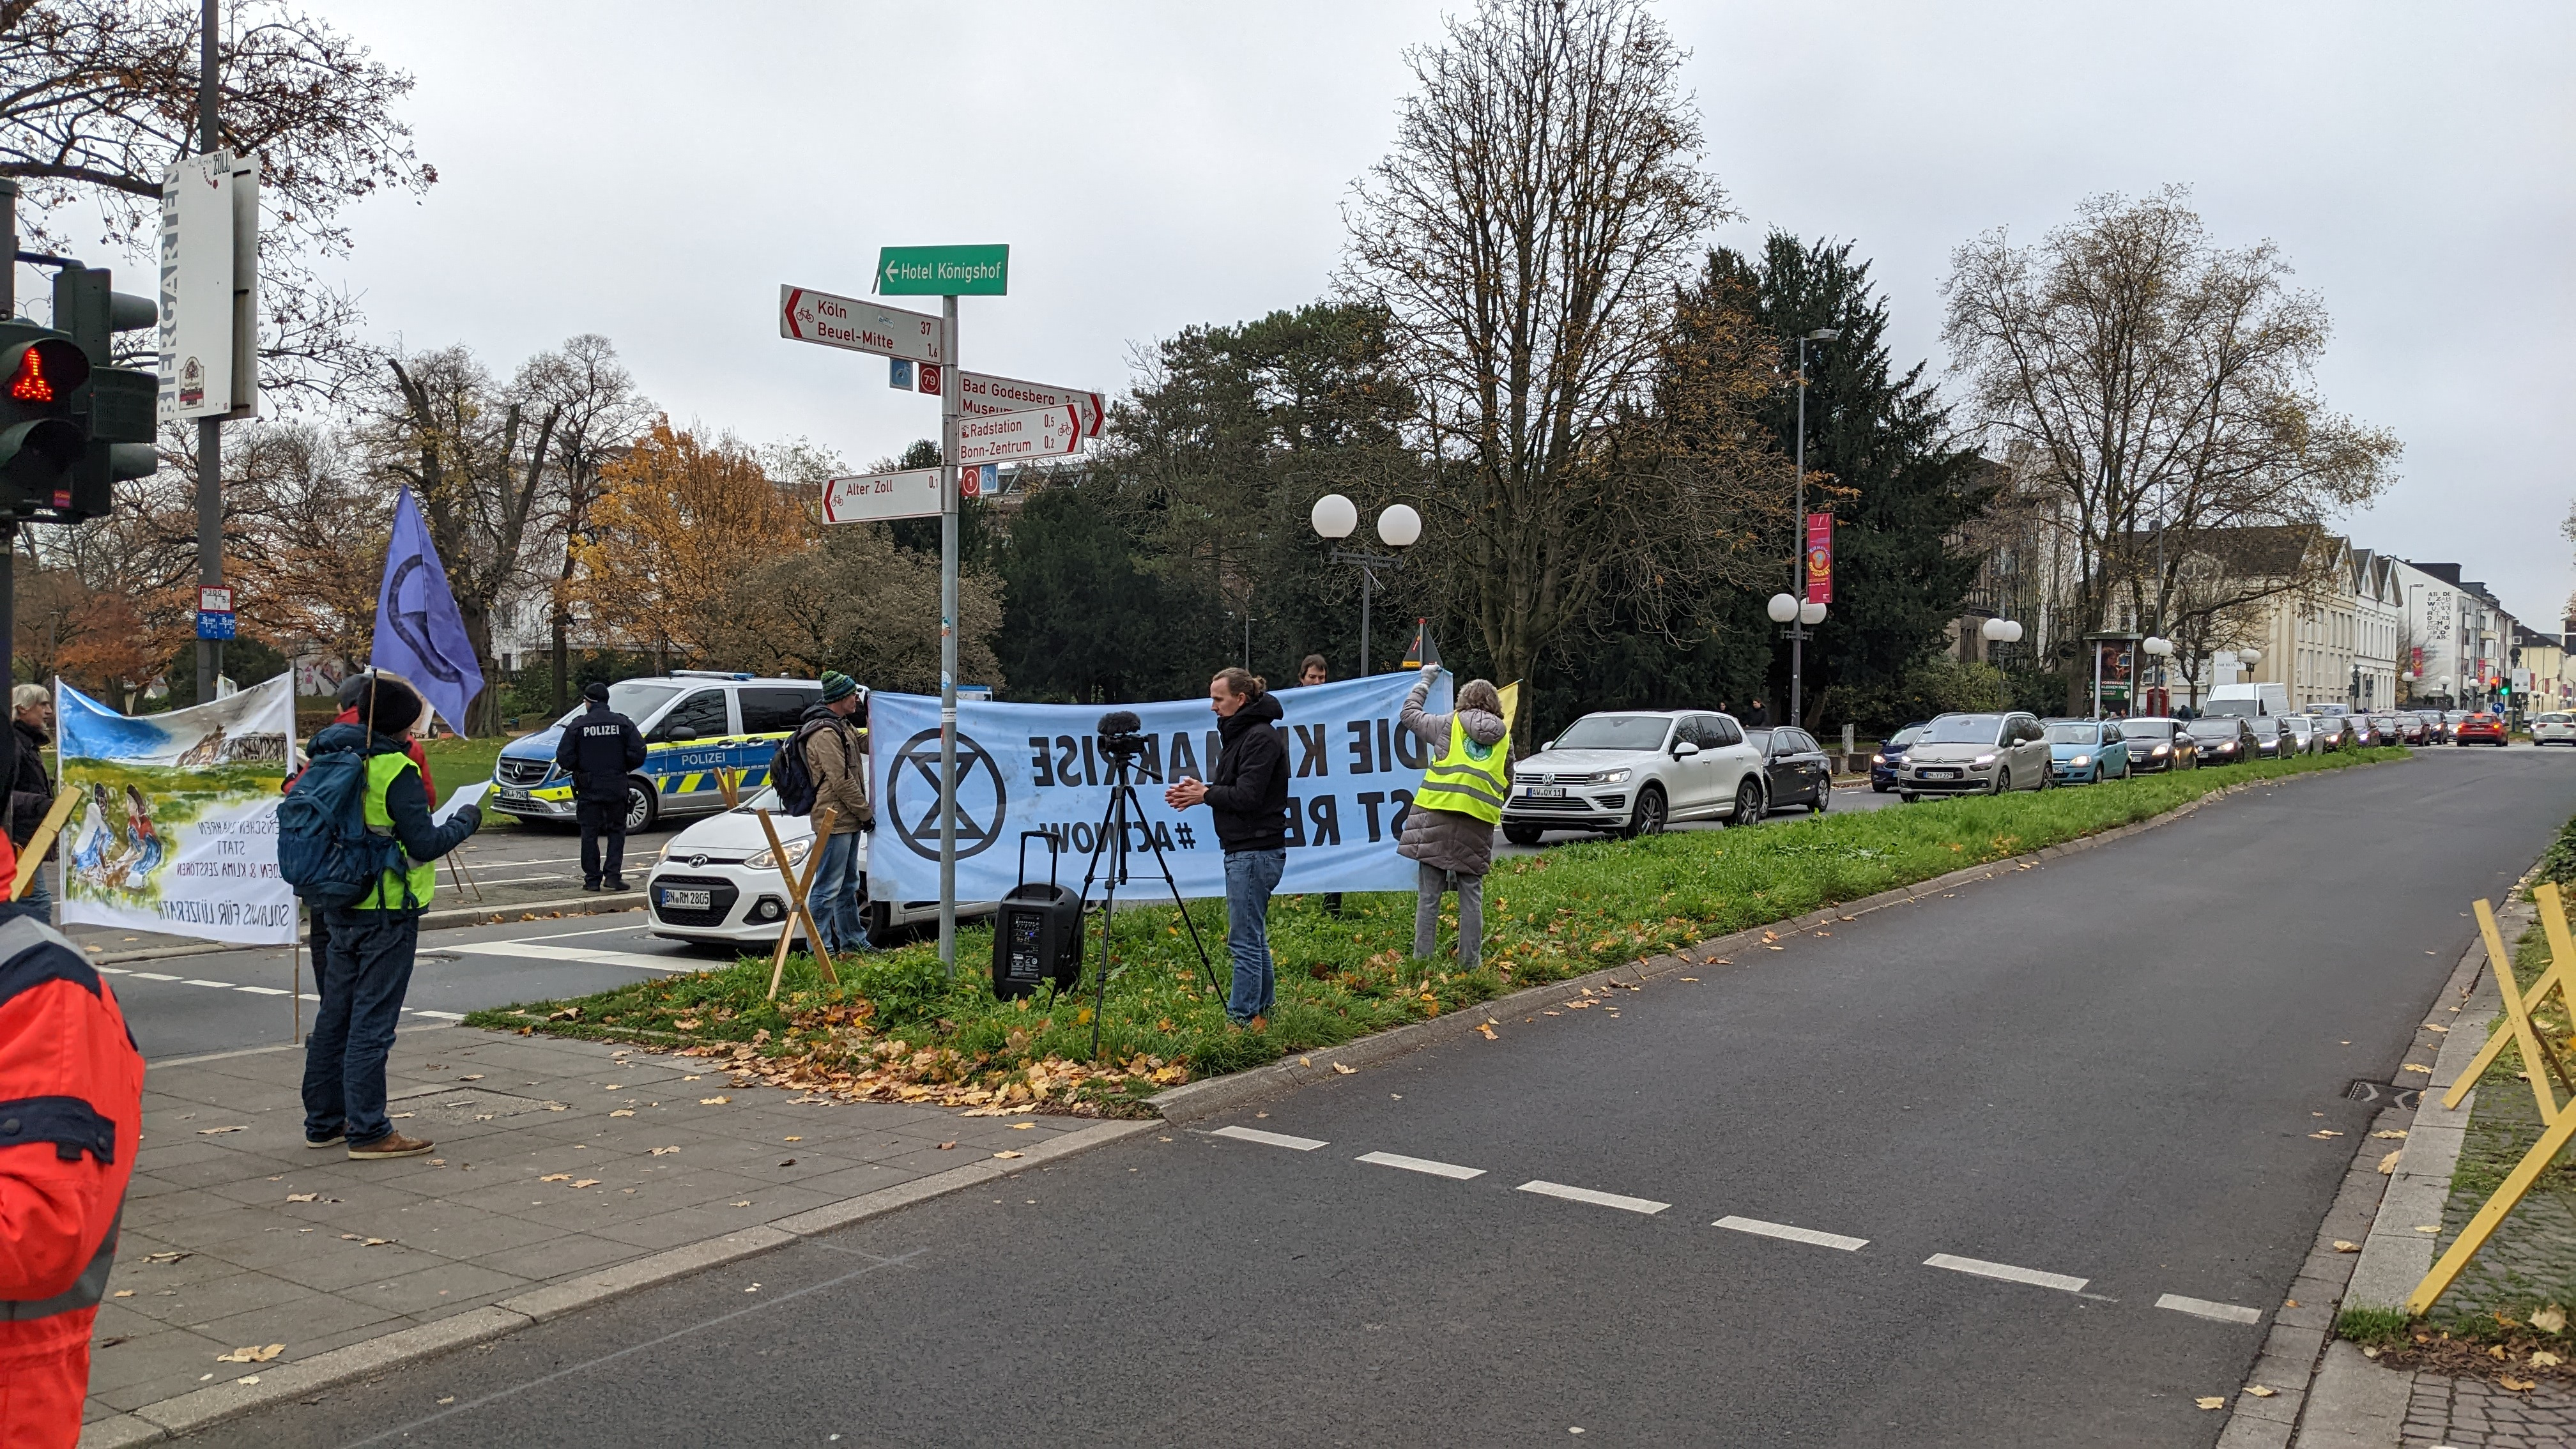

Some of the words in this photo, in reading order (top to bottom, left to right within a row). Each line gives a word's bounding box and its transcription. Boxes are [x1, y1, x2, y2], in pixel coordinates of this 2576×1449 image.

[213, 151, 230, 176] ZOLL
[901, 263, 932, 279] Hotel
[938, 261, 1001, 283] Königshof
[158, 170, 180, 413] BIERGARTEN
[818, 300, 847, 319] Köln
[818, 321, 893, 349] Beuel-Mitte
[921, 321, 931, 335] 37
[928, 343, 937, 358] 1,6
[924, 374, 935, 386] 79
[963, 378, 986, 394] Bad
[992, 383, 1055, 405] Godesberg
[1045, 414, 1054, 427] 0,5
[971, 420, 1022, 437] Radstation
[1045, 435, 1054, 448] 0,2
[961, 440, 1031, 459] Bonn-Zentrum
[847, 483, 870, 496] Alter
[875, 480, 893, 494] Zoll
[929, 475, 938, 489] 0,1
[968, 477, 972, 486] 1
[583, 725, 619, 737] POLIZEI
[682, 752, 725, 765] POLIZEI
[666, 891, 675, 903] BN
[680, 892, 689, 904] RM
[690, 893, 709, 905] 2805
